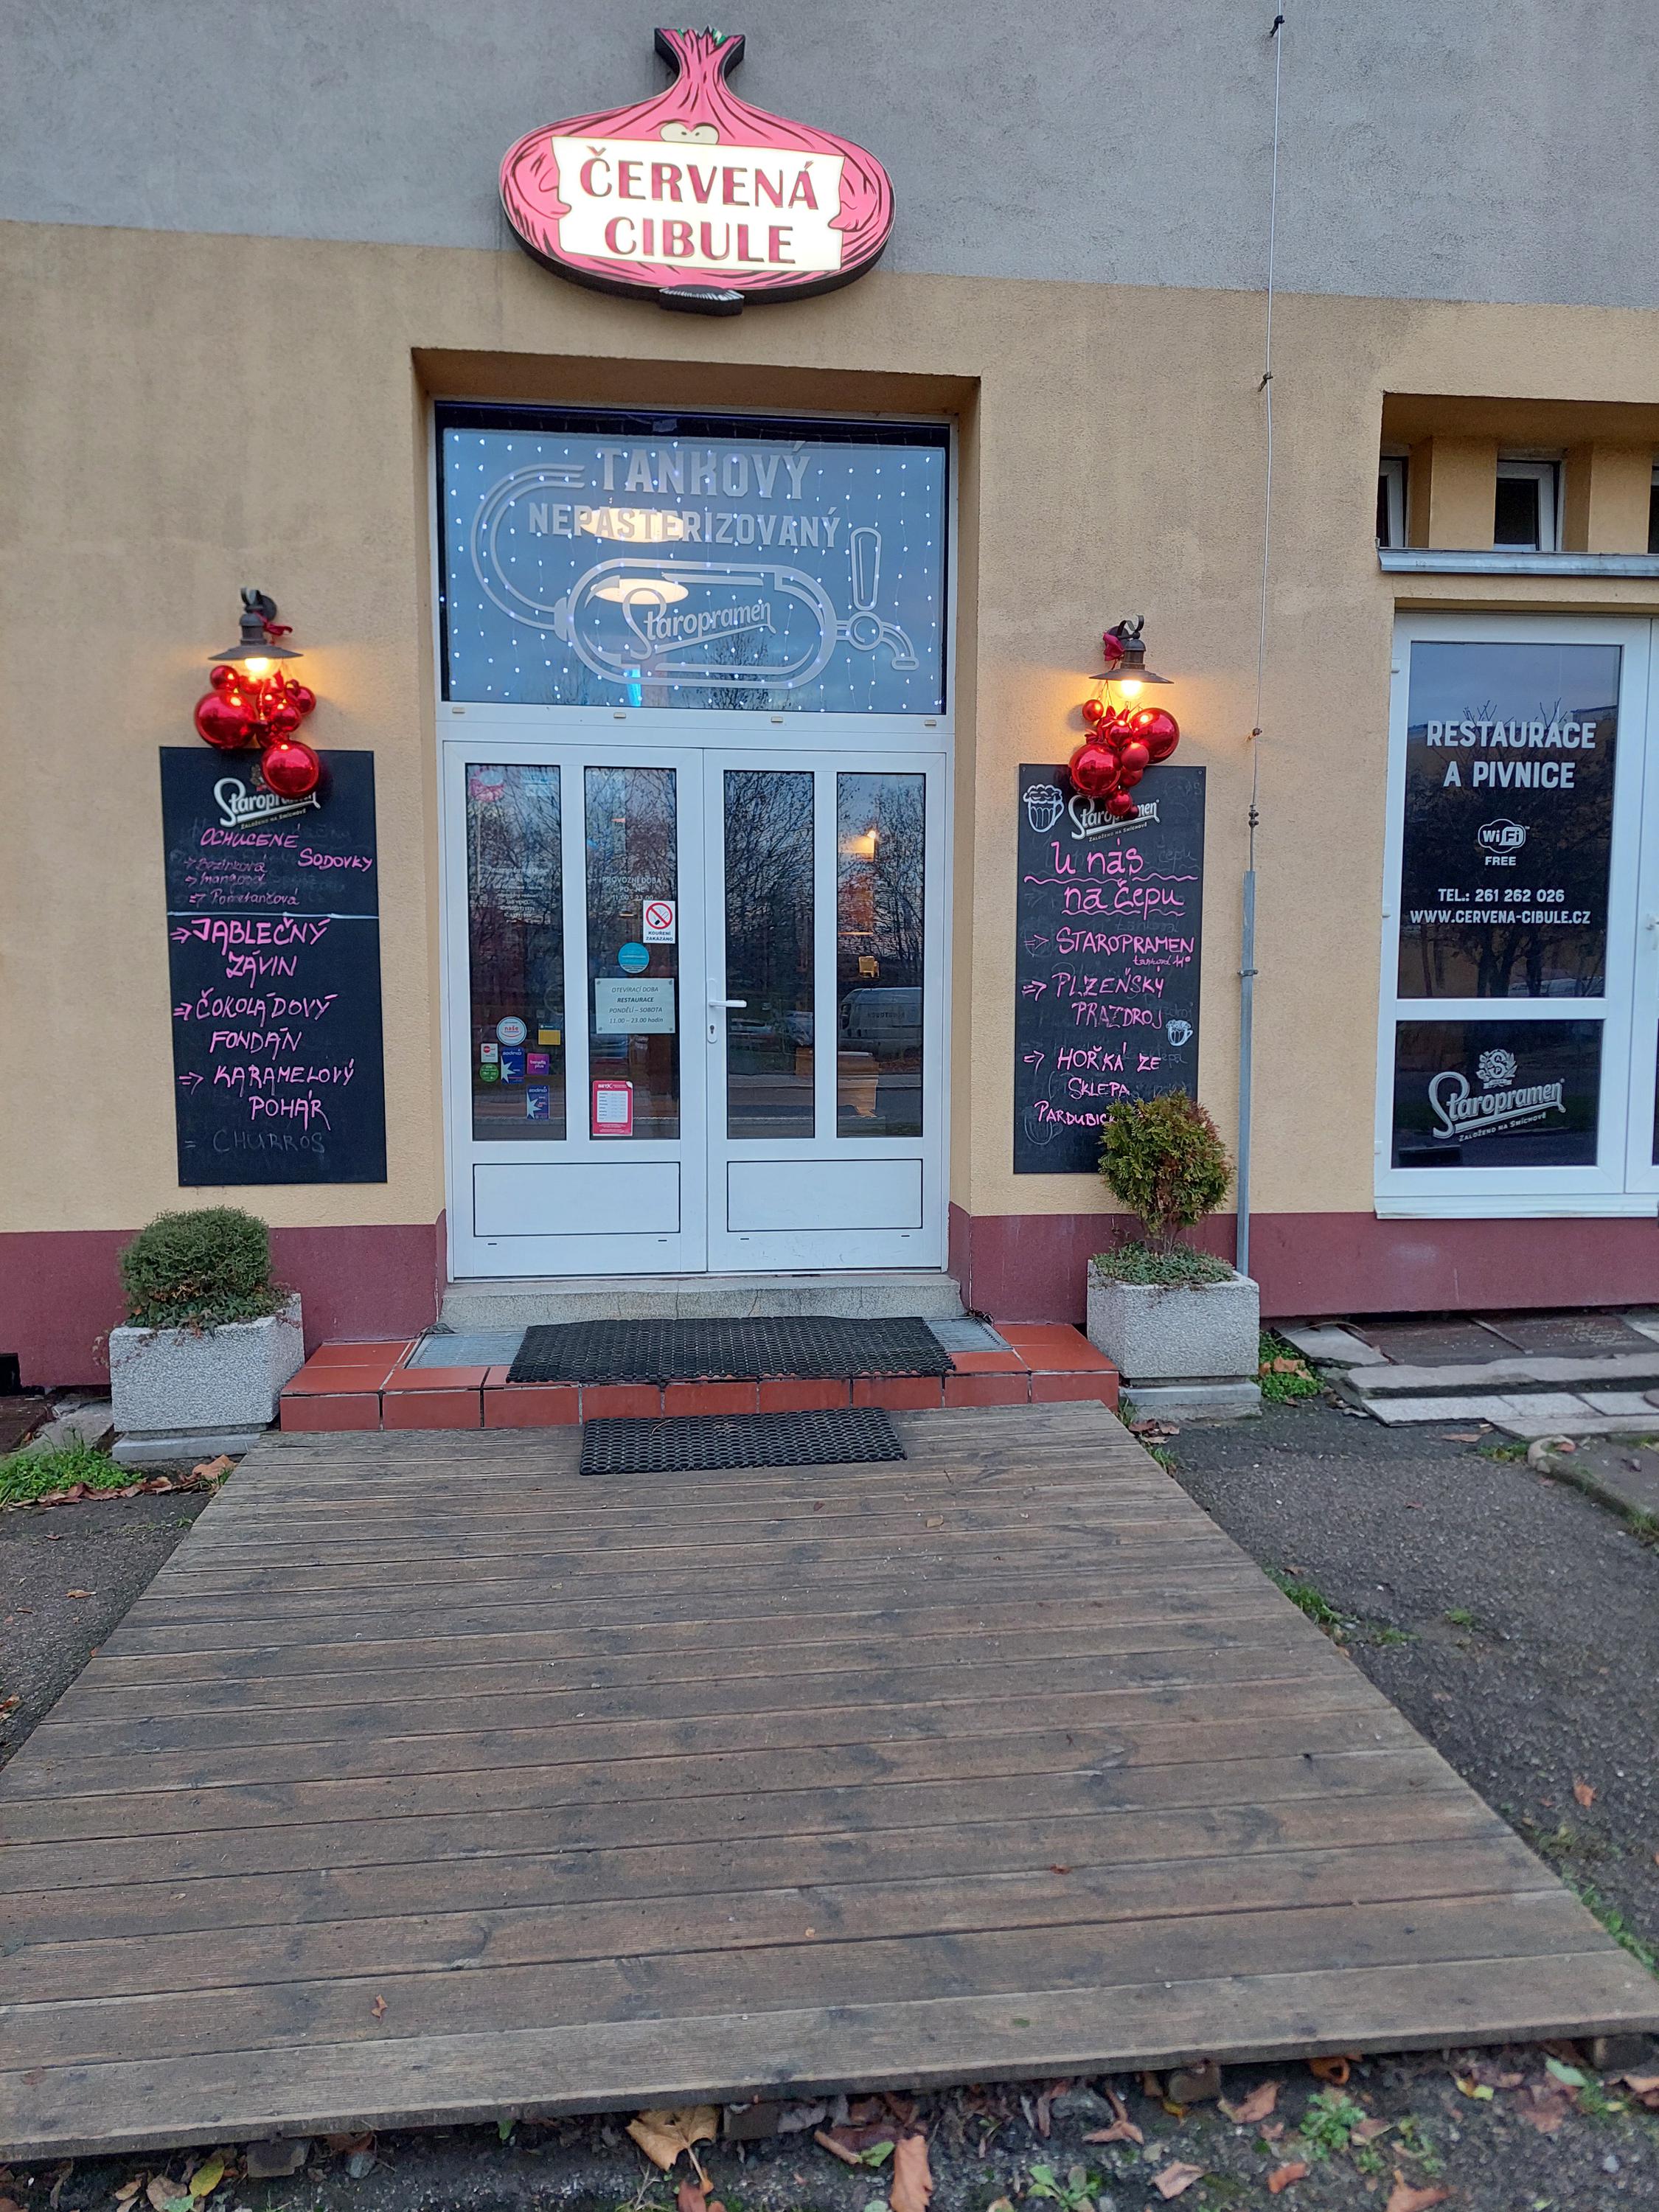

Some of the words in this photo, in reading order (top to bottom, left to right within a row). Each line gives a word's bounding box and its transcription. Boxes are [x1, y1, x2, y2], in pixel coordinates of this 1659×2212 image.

[580, 145, 820, 210] ČERVENÁ
[605, 216, 796, 265] CIBULE
[597, 442, 810, 500] TANKOVÝ
[528, 503, 841, 548] NEPASTERIZOVANÝ
[622, 588, 776, 660] Staropramen
[1427, 720, 1596, 748] RESTAURACE
[1443, 761, 1461, 787] A
[1472, 762, 1576, 789] PIVNICE
[200, 823, 302, 848] OCHUCENÉ
[298, 848, 373, 872] SODOVKY
[1087, 838, 1144, 876] nás
[1484, 856, 1517, 866] FREE
[1064, 886, 1108, 911] na
[1114, 878, 1184, 921] čepu
[1439, 888, 1470, 902] TEL.:
[1475, 889, 1498, 902] 261
[1503, 889, 1531, 902] 262
[1537, 889, 1565, 902] 026
[1410, 910, 1591, 924] WWW.CERVENA-CIBULE.CZ
[192, 917, 331, 956] JABLEČNÝ
[1056, 926, 1194, 955] STAROPRAMEN
[226, 950, 297, 989] ZÁVIN
[196, 987, 338, 1027] ČOKOLÁDOVÝ
[1071, 1001, 1163, 1029] PRAZDROJ
[209, 1027, 302, 1061] FONDÁN
[1057, 1042, 1127, 1071] HOŘKÁ
[1136, 1053, 1163, 1073] ZE
[214, 1058, 355, 1097] KARAMELOVÝ
[1068, 1077, 1130, 1100] SKLEPA
[248, 1090, 331, 1131] POHÁR
[1428, 1071, 1566, 1139] Staropramen
